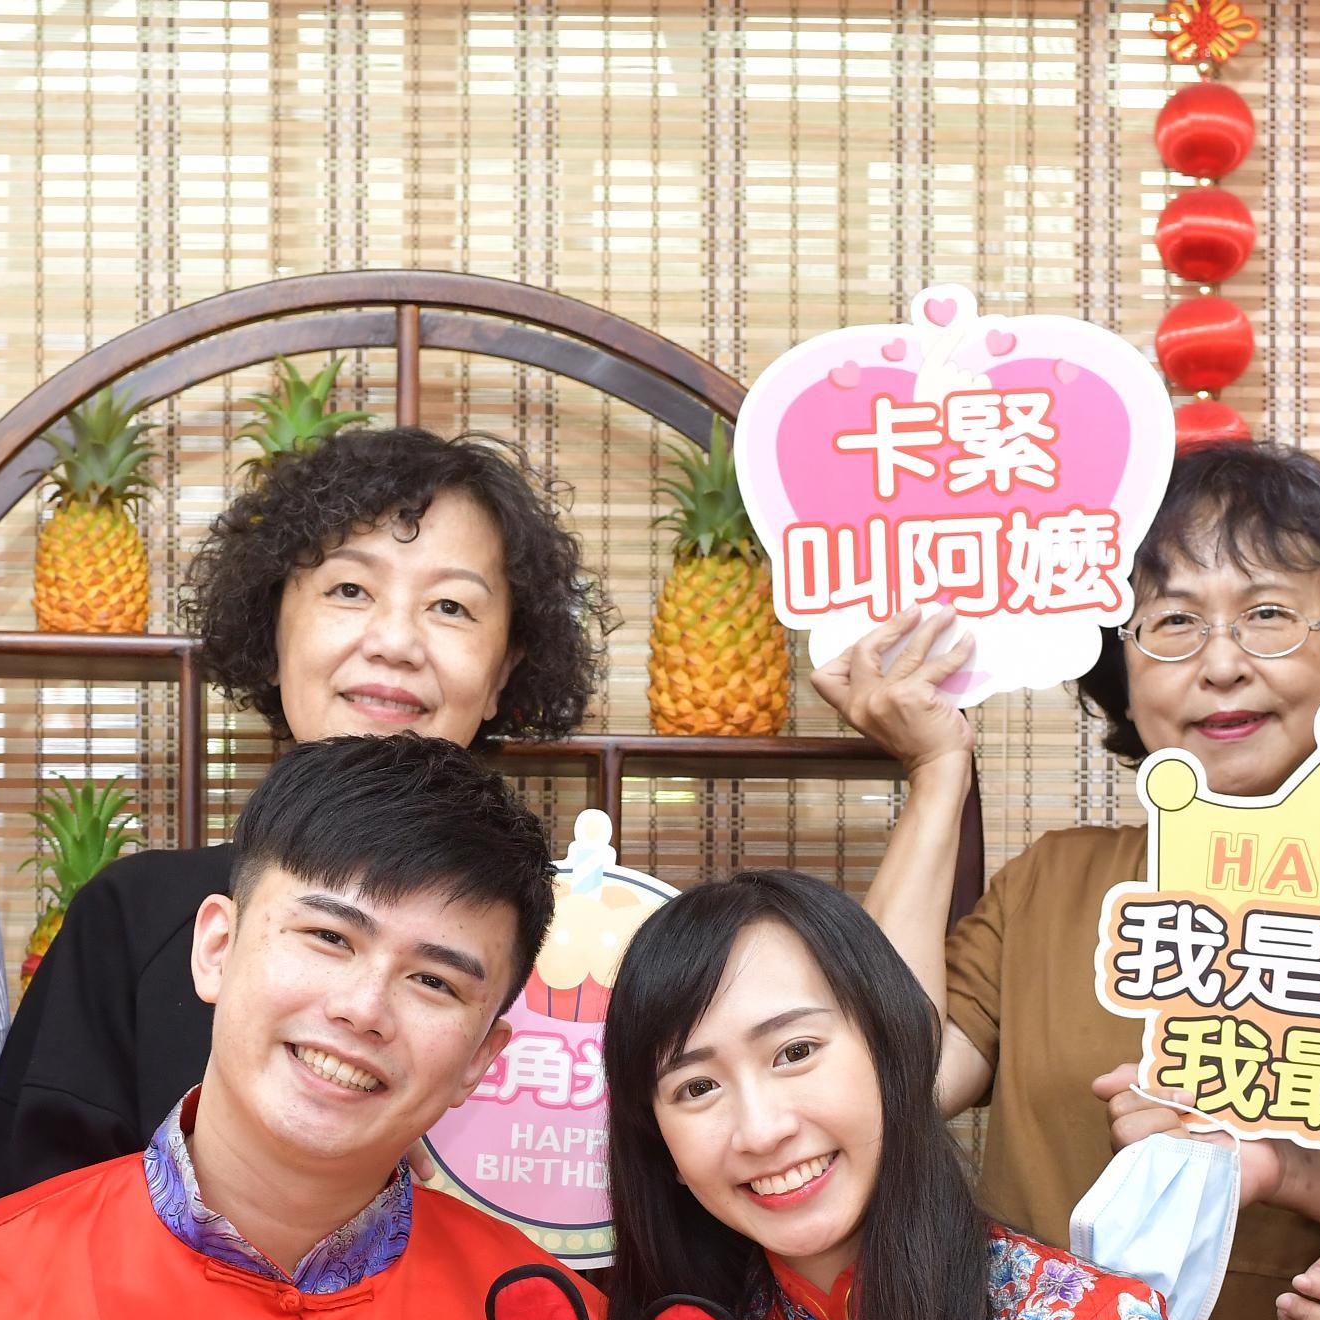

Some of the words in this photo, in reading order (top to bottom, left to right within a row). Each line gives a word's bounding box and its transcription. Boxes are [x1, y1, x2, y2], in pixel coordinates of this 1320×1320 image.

[836, 392, 1057, 498] 卡緊
[786, 508, 1120, 619] 叫阿嬤
